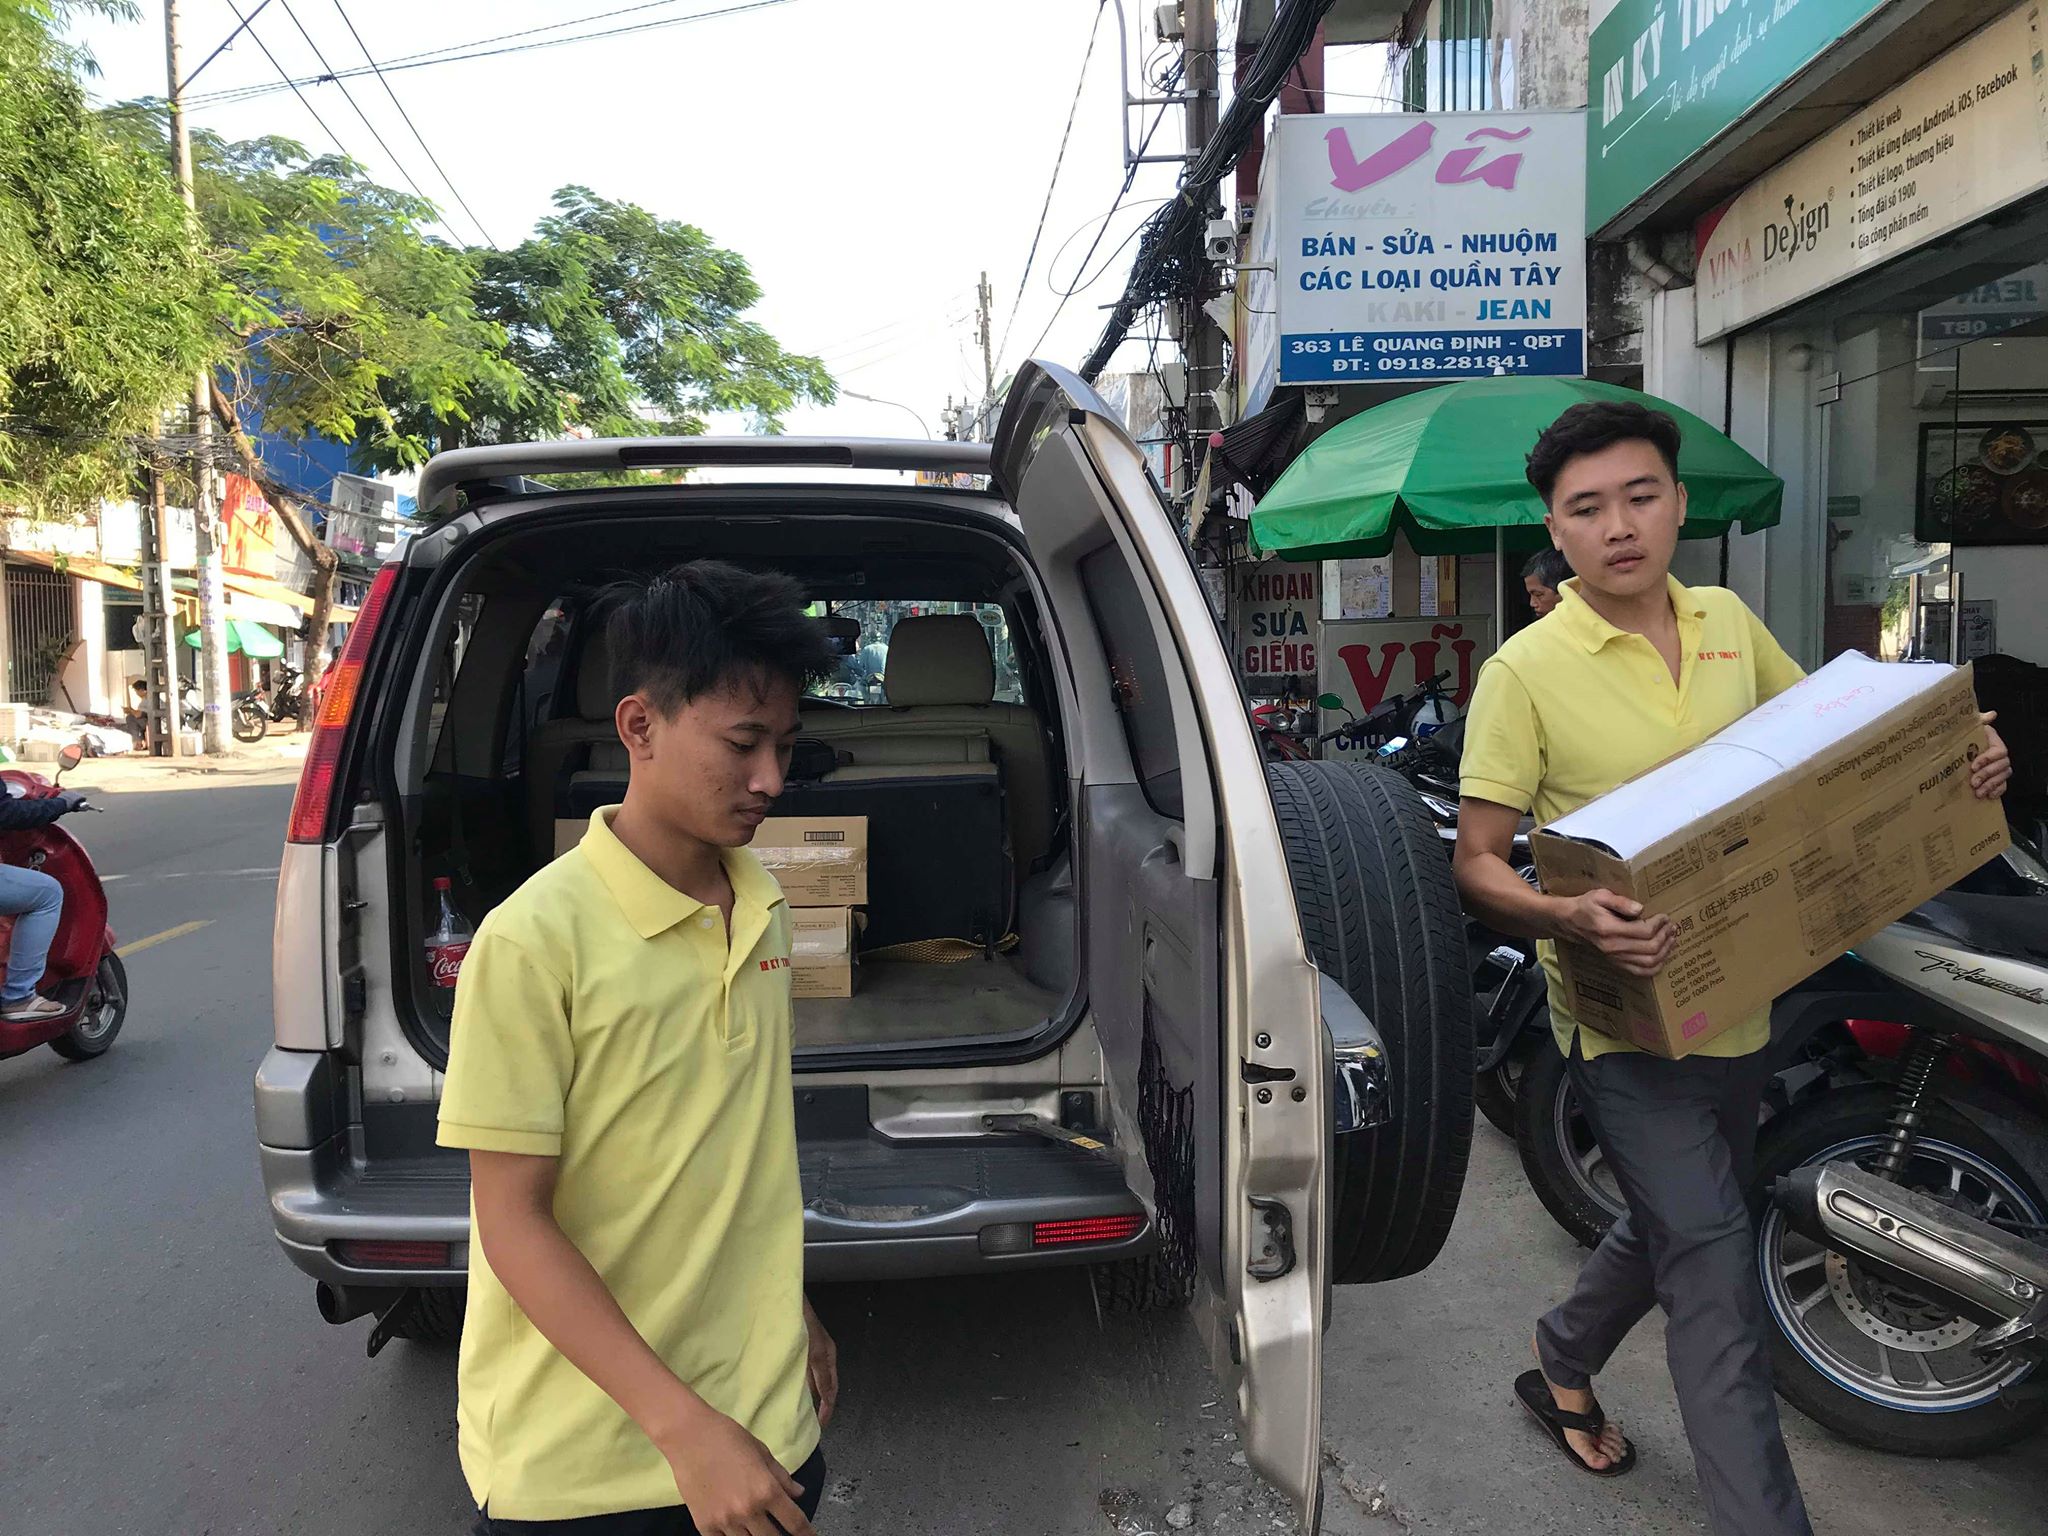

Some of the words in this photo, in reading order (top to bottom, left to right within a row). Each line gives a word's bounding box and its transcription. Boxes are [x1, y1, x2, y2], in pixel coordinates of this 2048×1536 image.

[1857, 147, 1875, 172] Thiết
[1877, 140, 1885, 160] kế
[1902, 124, 1921, 147] dụng
[1923, 100, 1957, 133] Android,
[1958, 90, 1975, 113] iOS,
[1976, 64, 2018, 102] Facebook
[1857, 120, 1875, 145] Thiết
[1877, 115, 1885, 134] kế
[1886, 105, 1902, 127] web
[1324, 120, 1533, 193] Vũ
[1858, 176, 1875, 198] Thiết
[1877, 168, 1885, 188] kế
[1886, 163, 1905, 182] logo,
[1906, 146, 1934, 171] thương
[1936, 134, 1954, 155] hiệu
[1876, 195, 1887, 214] đài
[1888, 188, 1897, 208] số
[1898, 181, 1917, 203] 1900
[1301, 231, 1356, 256] BÁN
[1382, 228, 1435, 255] SỬA
[1461, 227, 1557, 256] NHUỘM
[1859, 233, 1869, 249] Gia
[1871, 227, 1887, 243] công
[1299, 265, 1352, 291] CÁC
[1361, 269, 1421, 293] LOẠI
[1429, 259, 1501, 291] QUẦN
[1510, 261, 1561, 287] TÂY
[1710, 237, 1752, 286] VINA
[1367, 300, 1446, 323] KAKI
[1476, 299, 1551, 320] JEAN
[1291, 340, 1331, 354] 363
[1339, 336, 1365, 352] LÊ
[1373, 337, 1444, 352] QUANG
[1450, 336, 1501, 353] ĐỊNH
[1523, 335, 1566, 350] QBT
[1332, 358, 1370, 372] ĐT:
[1377, 355, 1529, 372] 0918.281841
[1242, 573, 1313, 601] KHOAN
[1252, 602, 1308, 637] SỬA
[1245, 636, 1316, 673] GIẾNG
[1338, 623, 1476, 716] VŨ
[1817, 759, 1862, 787] Magenta
[1860, 754, 1904, 782] Magenta
[1668, 966, 1683, 979] Color
[1684, 957, 1697, 968] 800
[1697, 948, 1713, 961] Press
[1671, 975, 1686, 988] Color
[1701, 958, 1717, 970] Press
[1673, 986, 1688, 999] Color
[1689, 974, 1705, 987] 1000
[1705, 966, 1721, 979] Press
[1676, 995, 1691, 1008] Color
[1709, 975, 1726, 988] Press
